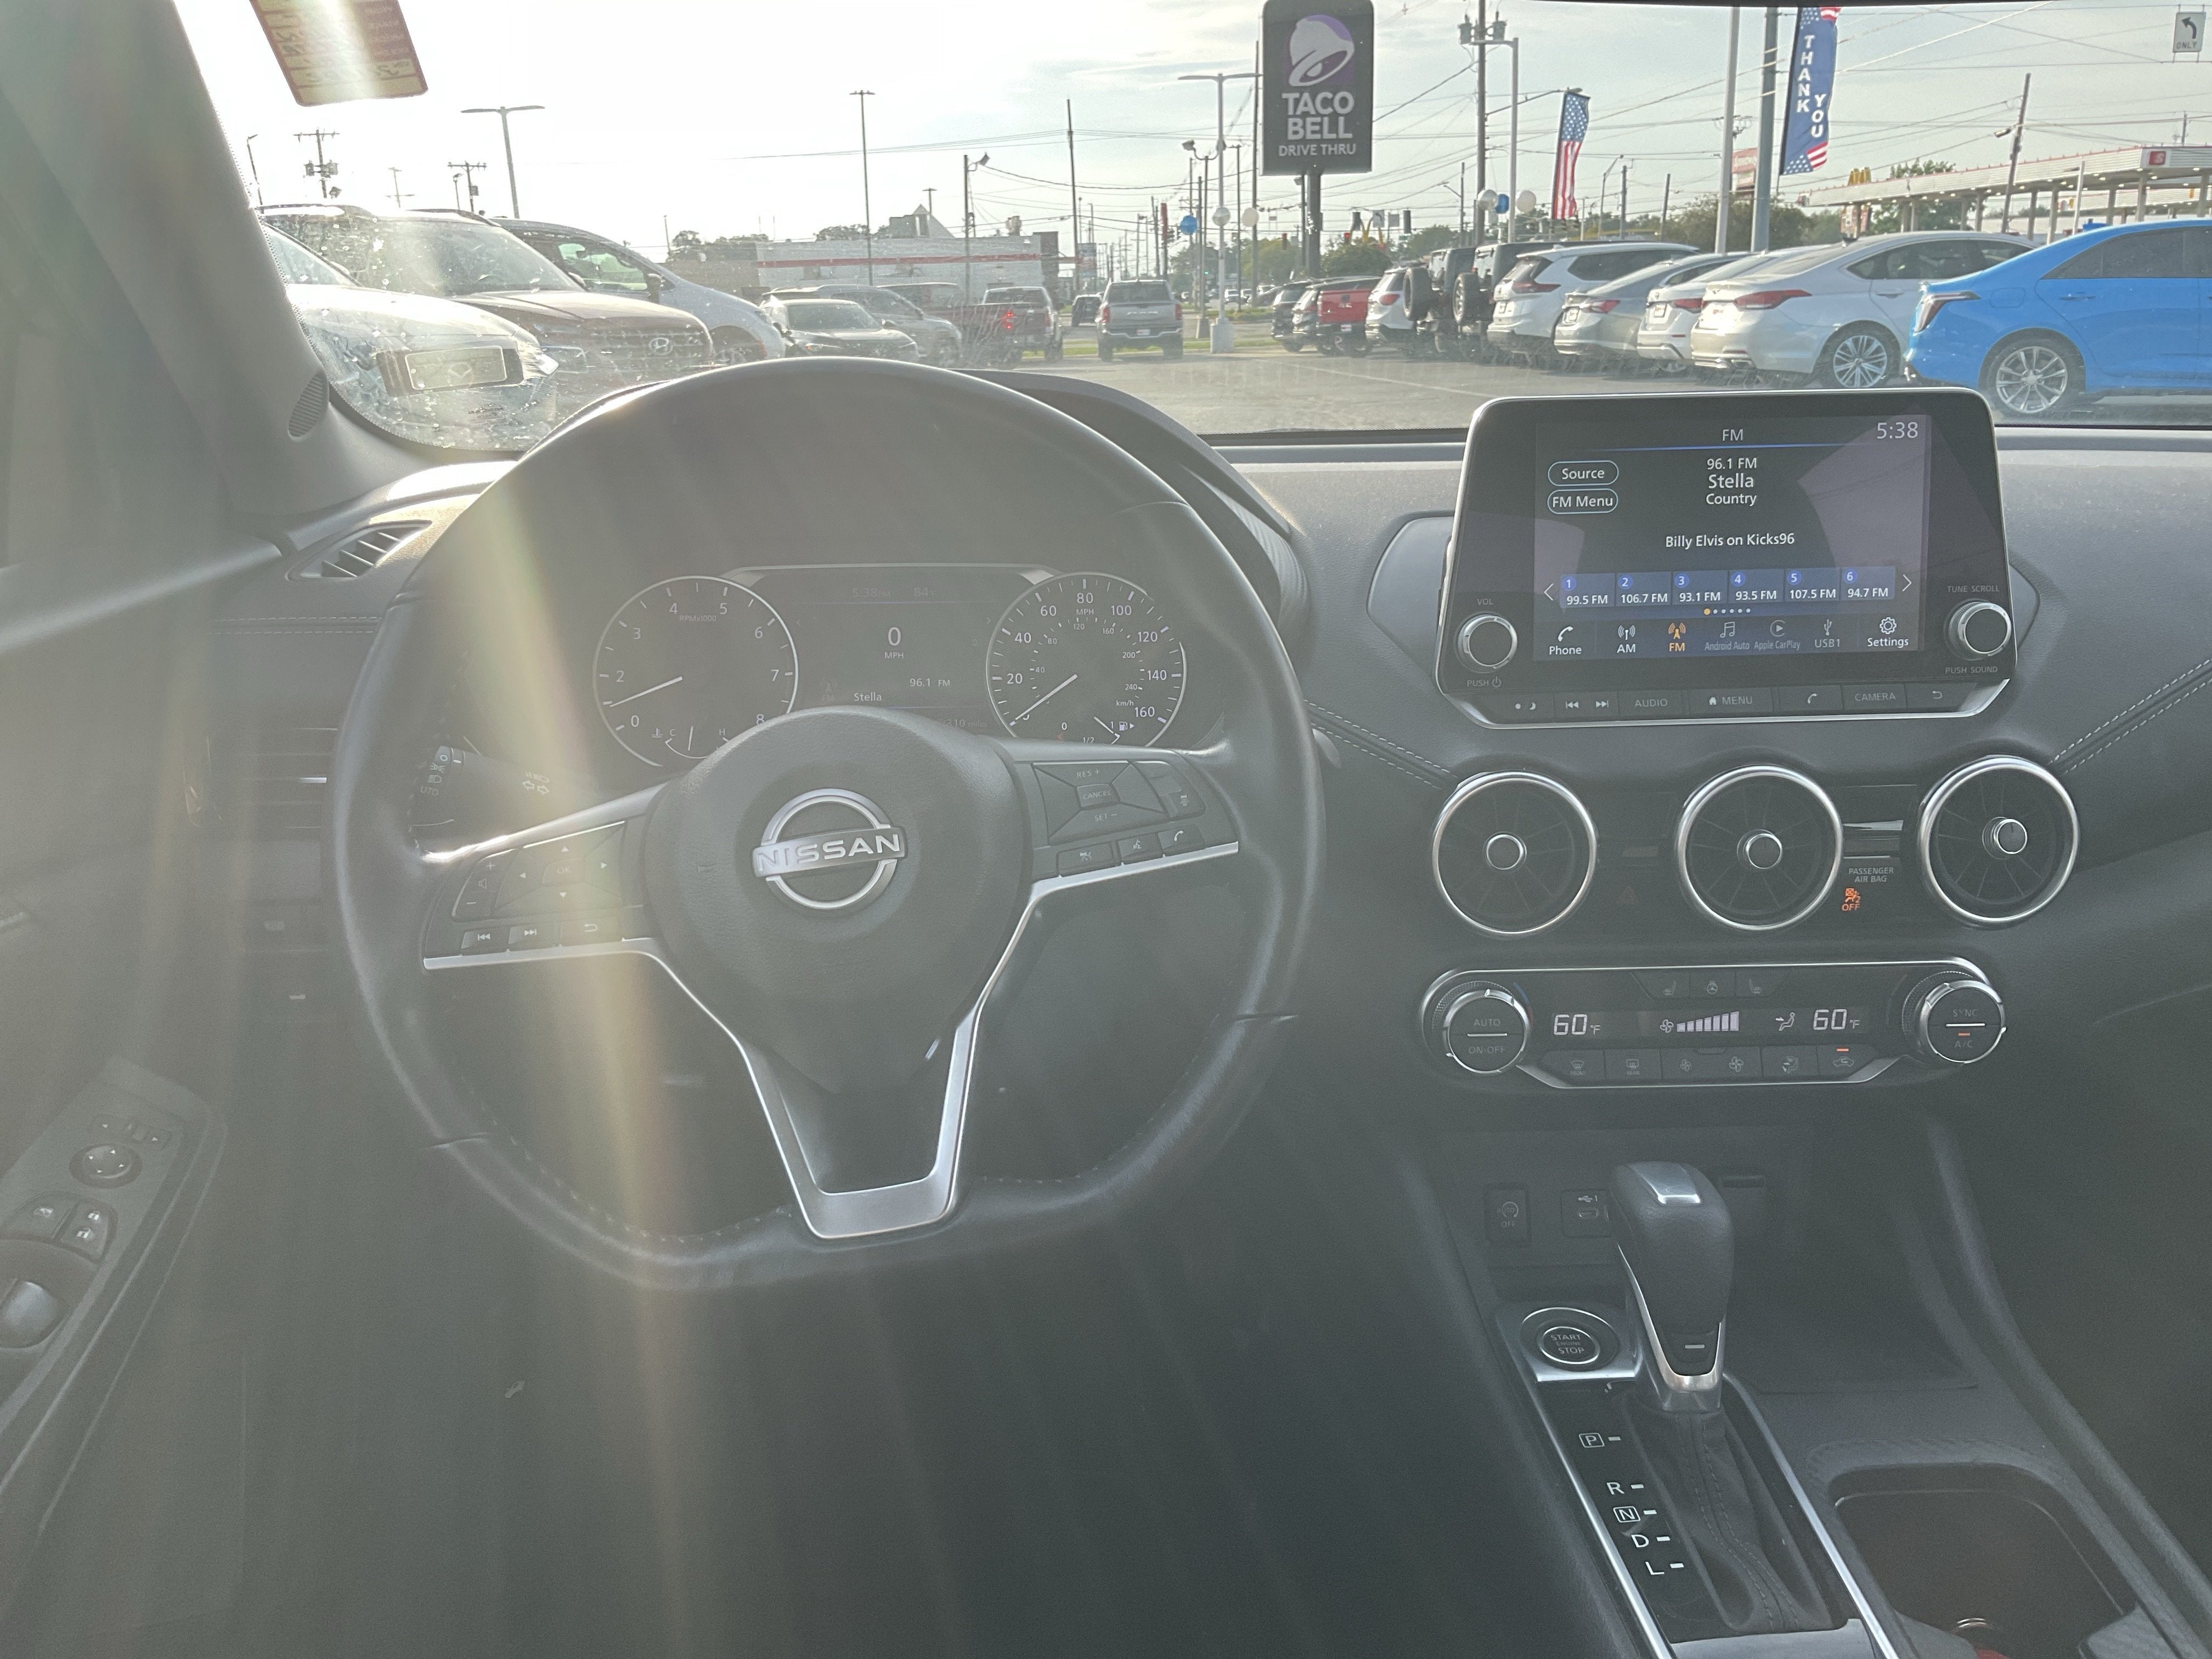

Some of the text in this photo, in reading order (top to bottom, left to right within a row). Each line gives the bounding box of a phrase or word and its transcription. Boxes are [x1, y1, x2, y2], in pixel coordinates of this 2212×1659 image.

[1797, 35, 1815, 113] THANK
[1282, 92, 1355, 115] TACO
[1811, 93, 1826, 138] YOU
[1287, 116, 1353, 140] BELL
[1278, 143, 1356, 156] DRIVE THRU
[1722, 429, 1743, 441] FM
[1877, 422, 1918, 439] 5:38
[1707, 458, 1757, 470] 96.1 FM
[1561, 468, 1605, 480] Source
[1708, 473, 1754, 489] Stella
[1552, 495, 1613, 507] FM Menu
[1706, 493, 1757, 506] Country
[1666, 533, 1795, 550] Billy Elvis on Kicks96
[1621, 577, 1628, 587] 2
[1678, 576, 1685, 586] 3
[1734, 574, 1741, 584] 4
[1791, 573, 1798, 583] 5
[1847, 572, 1854, 582] 6
[1566, 579, 1571, 588] 1
[1076, 592, 1094, 604] 80
[1621, 593, 1668, 603] 106.7 FM
[1679, 592, 1721, 602] 93.1 FM
[1735, 590, 1777, 601] 93.5 FM
[1790, 589, 1836, 599] 107.5 FM
[1847, 588, 1888, 598] 94.7 FM
[1566, 595, 1608, 605] 99.5 FM
[669, 602, 678, 614] 4
[720, 602, 727, 615] 5
[1040, 605, 1057, 617] 60
[1111, 605, 1132, 616] 100
[633, 627, 641, 640] 3
[755, 626, 763, 639] 6
[888, 627, 901, 646] 0
[1014, 632, 1032, 644] 40
[1137, 631, 1158, 642] 120
[1669, 642, 1685, 652] FM
[1704, 641, 1750, 651] Android Auto
[1754, 640, 1801, 651] Apple CarPlay
[1814, 639, 1840, 648] USB1
[1867, 637, 1909, 648] Settings
[1549, 646, 1582, 655] Phone
[1616, 644, 1636, 653] AM
[616, 670, 624, 682] 2
[771, 669, 779, 681] 7
[1007, 673, 1023, 685] 20
[1147, 670, 1167, 681] 140
[910, 678, 931, 687] 96.1
[854, 692, 882, 702] Stella
[1722, 696, 1753, 705] MENU
[1854, 692, 1896, 702] CAMERA
[1634, 698, 1668, 708] AUDIO
[1135, 707, 1155, 718] 160
[631, 715, 640, 727] 0
[756, 714, 764, 725] 8
[1061, 722, 1068, 730] 0
[420, 786, 439, 797] UTO
[1083, 791, 1112, 800] CANCEL
[1094, 813, 1108, 822] SET
[758, 834, 900, 871] NISSAN
[1474, 1018, 1500, 1026] AUTO
[1954, 1040, 1973, 1048] A/C
[1585, 1435, 1597, 1446] P
[1607, 1482, 1624, 1495] R
[1619, 1509, 1635, 1520] N
[1631, 1534, 1649, 1548] D
[1645, 1561, 1664, 1575] L
